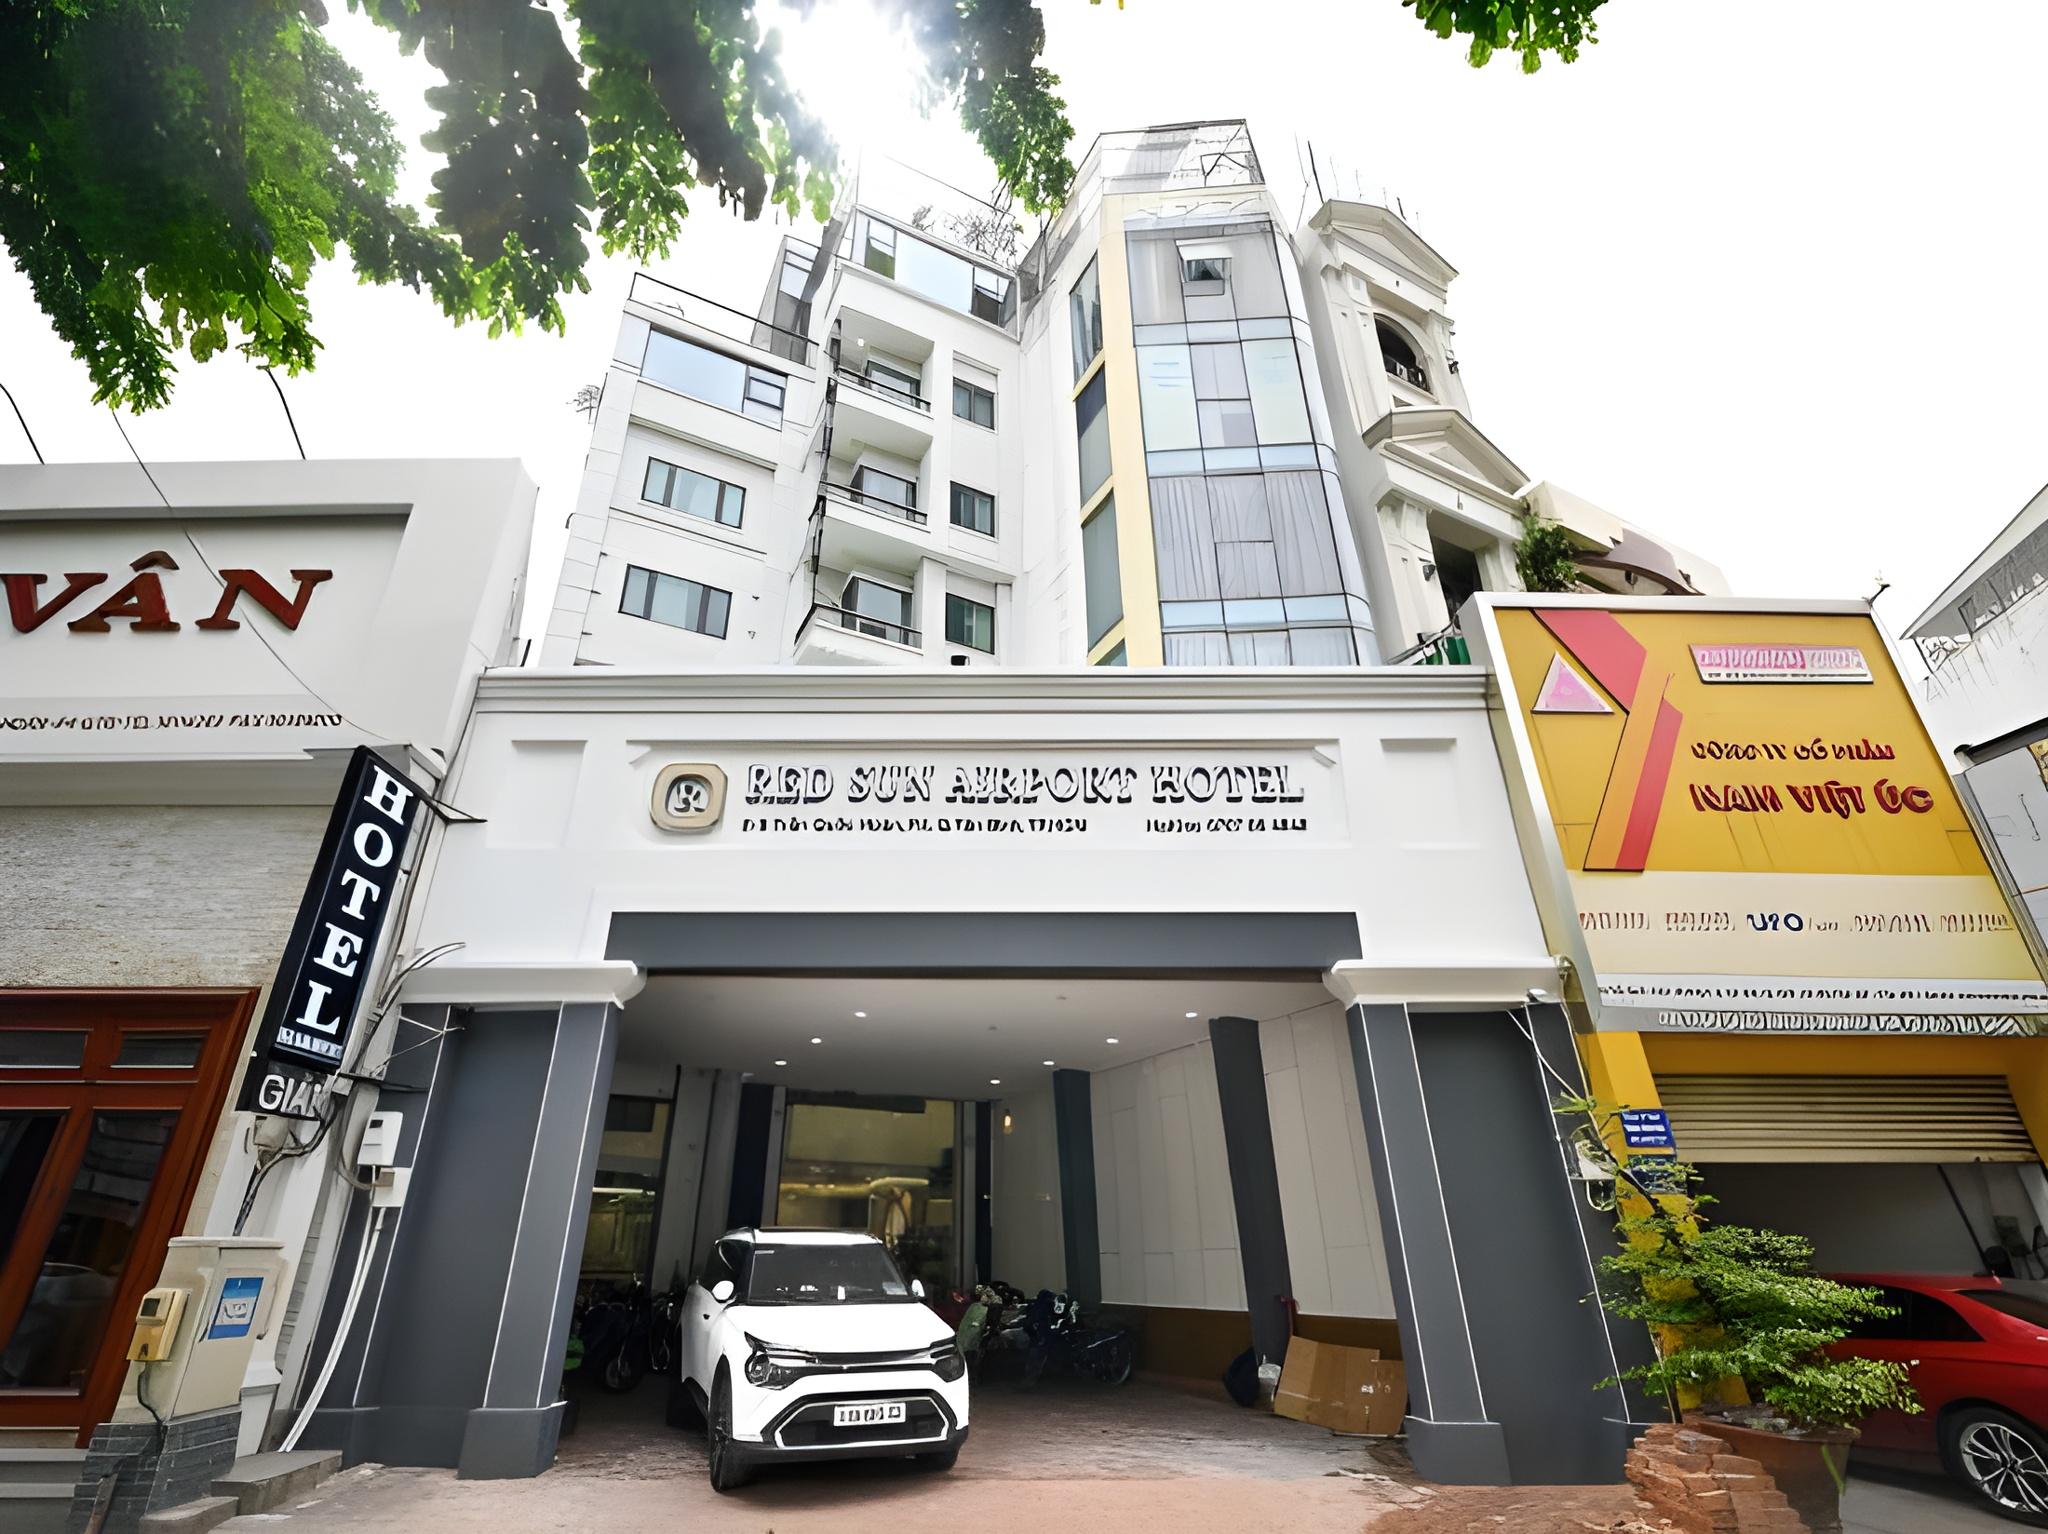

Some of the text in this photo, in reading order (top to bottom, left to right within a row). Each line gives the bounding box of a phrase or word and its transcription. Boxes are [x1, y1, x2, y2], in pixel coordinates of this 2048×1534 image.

[0, 550, 333, 634] VÂN
[745, 764, 1305, 804] RED SUN AIRPORT HOTEL
[296, 765, 414, 1035] HOTEL
